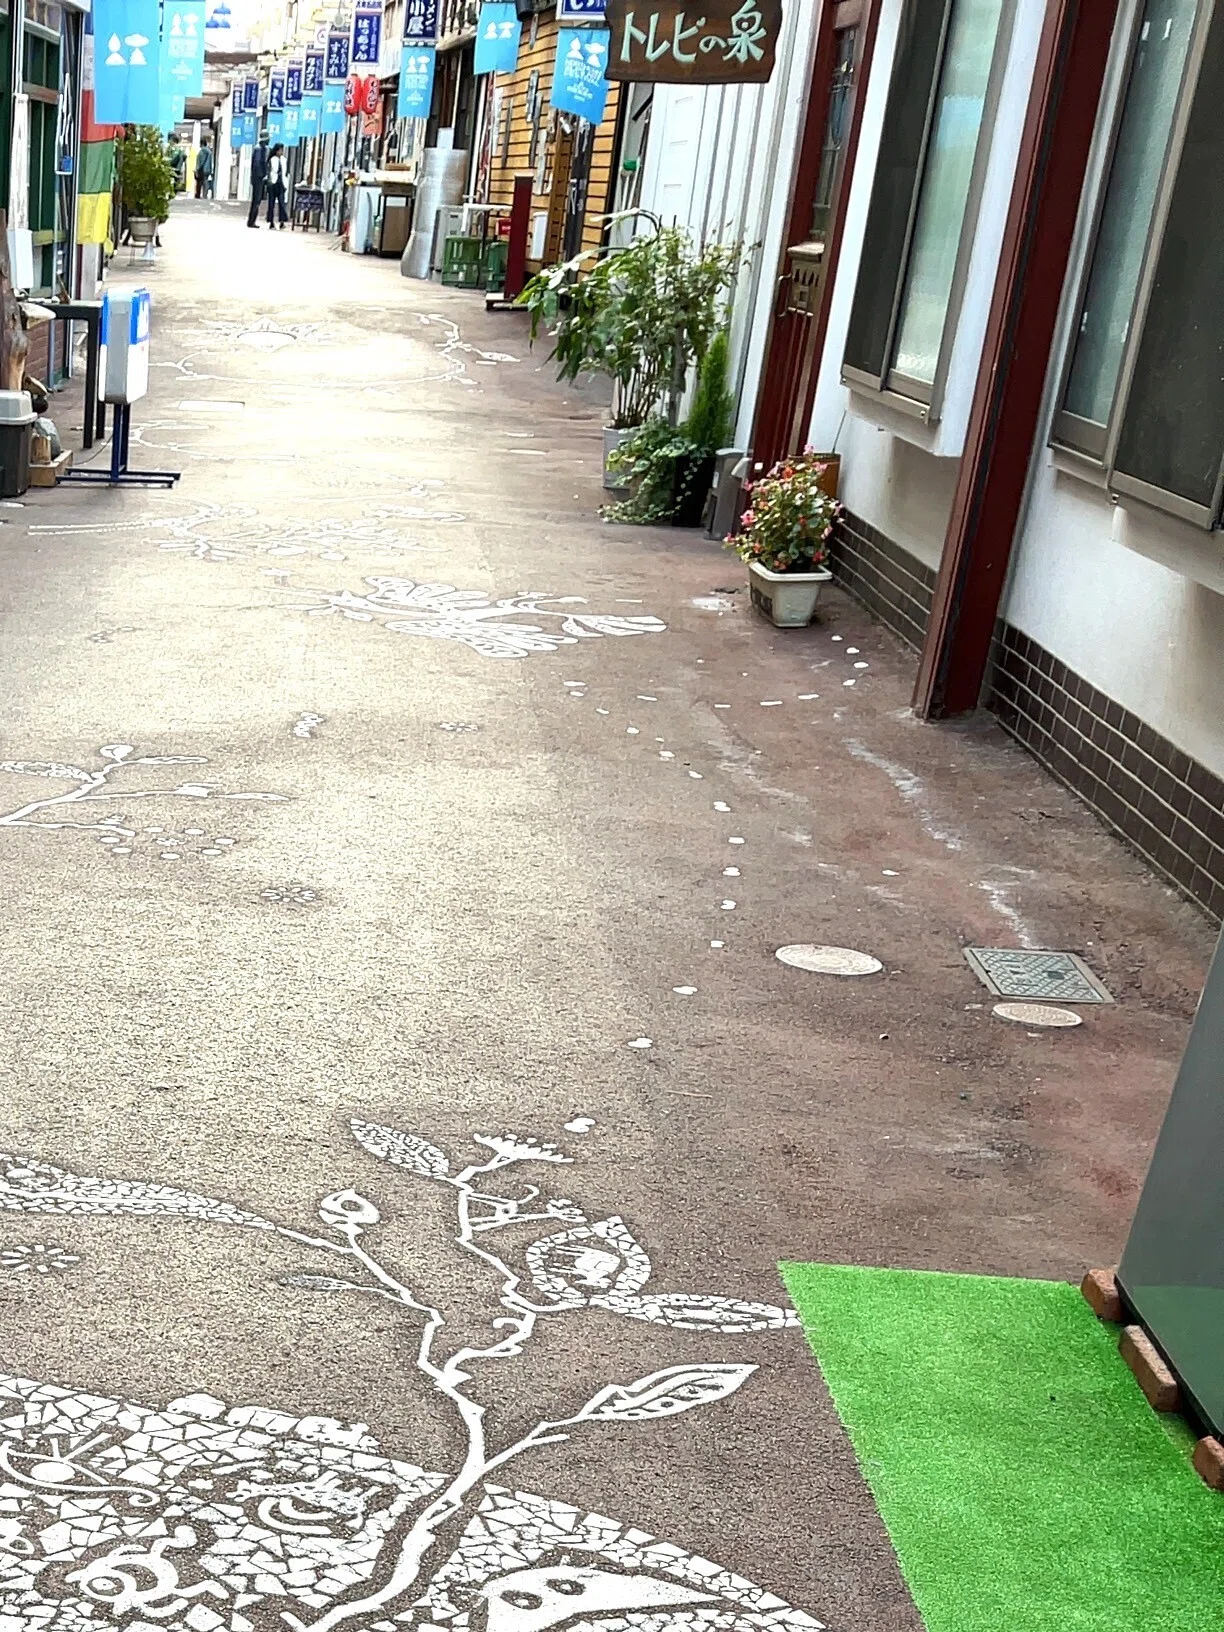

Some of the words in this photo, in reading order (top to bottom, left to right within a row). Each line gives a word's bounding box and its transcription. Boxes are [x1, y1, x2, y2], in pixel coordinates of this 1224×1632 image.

[620, 0, 767, 63] トレビの泉
